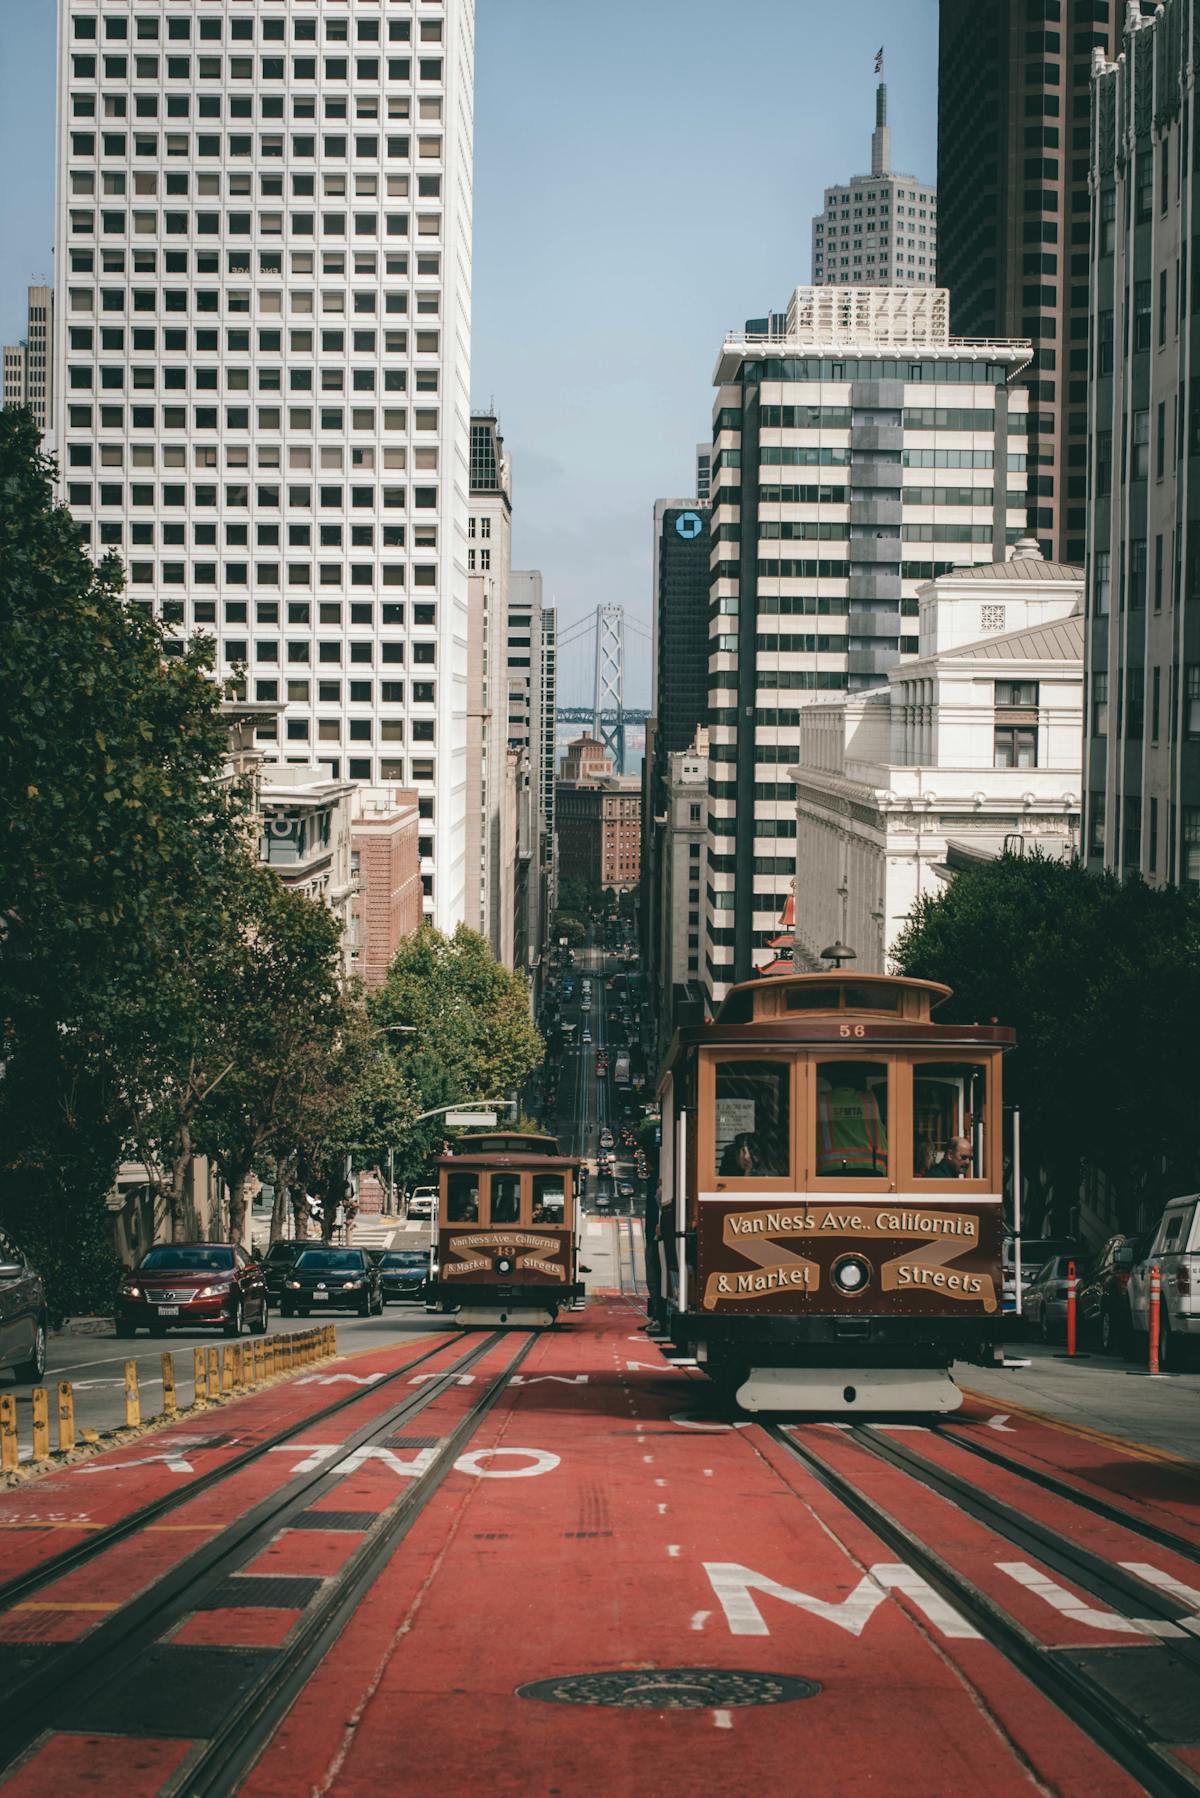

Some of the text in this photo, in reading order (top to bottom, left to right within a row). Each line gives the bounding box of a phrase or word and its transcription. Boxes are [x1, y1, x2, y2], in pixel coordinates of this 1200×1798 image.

[840, 1024, 865, 1037] 56
[876, 1212, 976, 1236] California
[515, 1235, 560, 1249] California
[493, 1246, 516, 1256] 49
[448, 1257, 561, 1272] & Market Streets
[717, 1266, 983, 1293] & Market Streets
